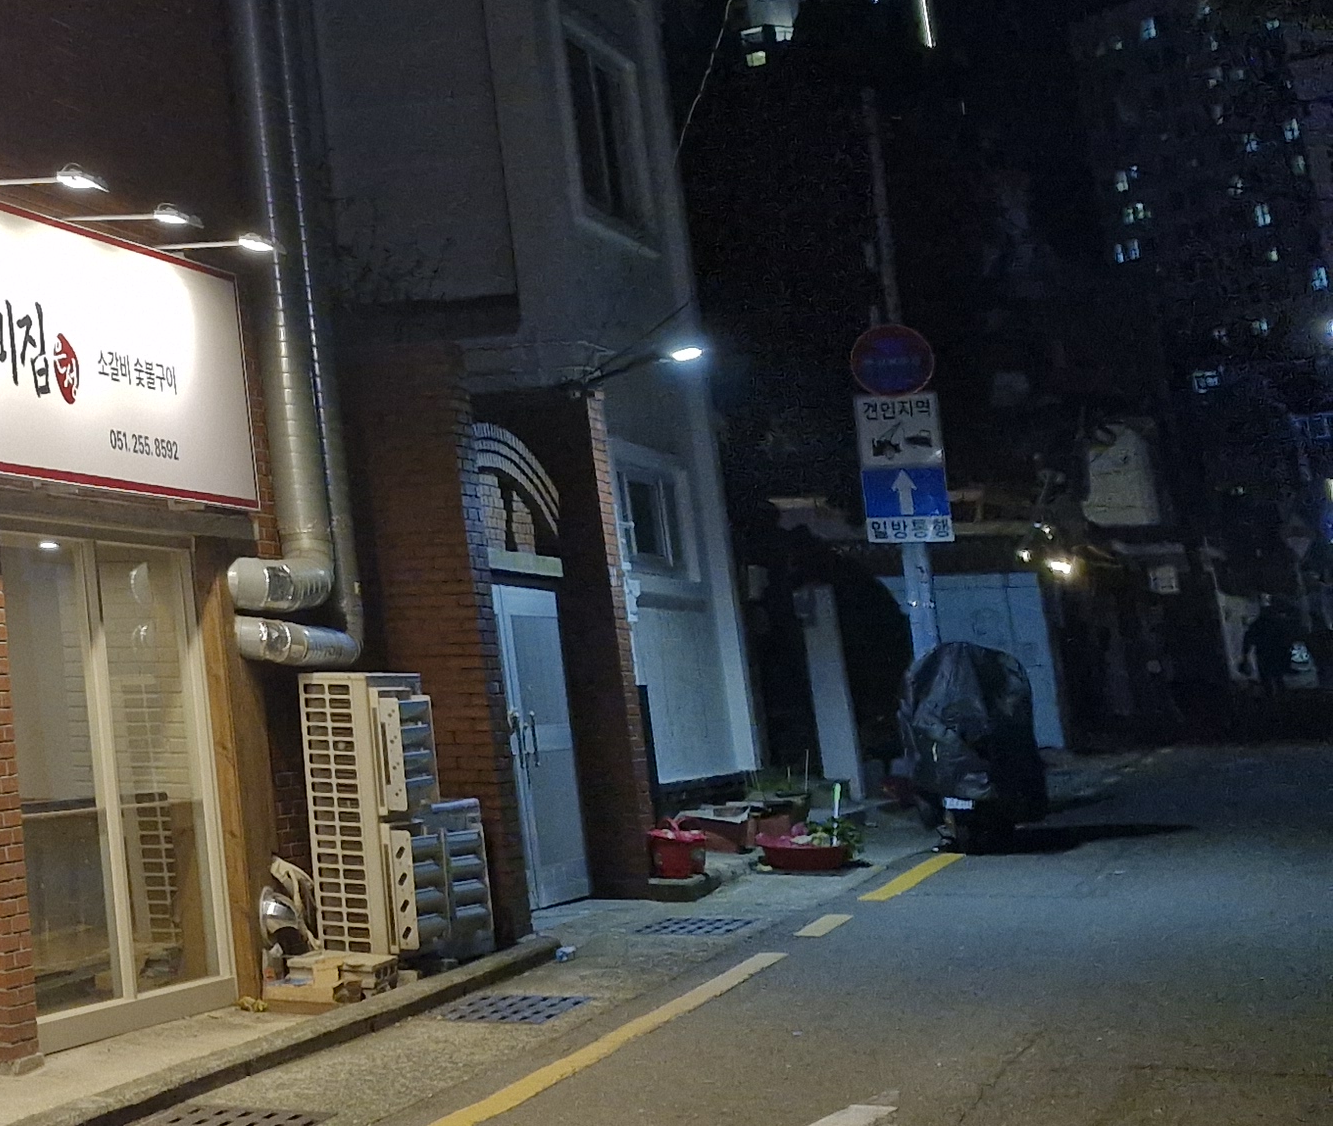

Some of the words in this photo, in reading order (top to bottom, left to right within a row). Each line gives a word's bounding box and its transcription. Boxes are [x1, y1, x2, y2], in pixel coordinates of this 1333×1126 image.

[97, 350, 132, 385] 소갈비
[133, 358, 177, 394] 숯불구이
[863, 398, 932, 421] 견인지역
[871, 517, 951, 540] 일방통행
